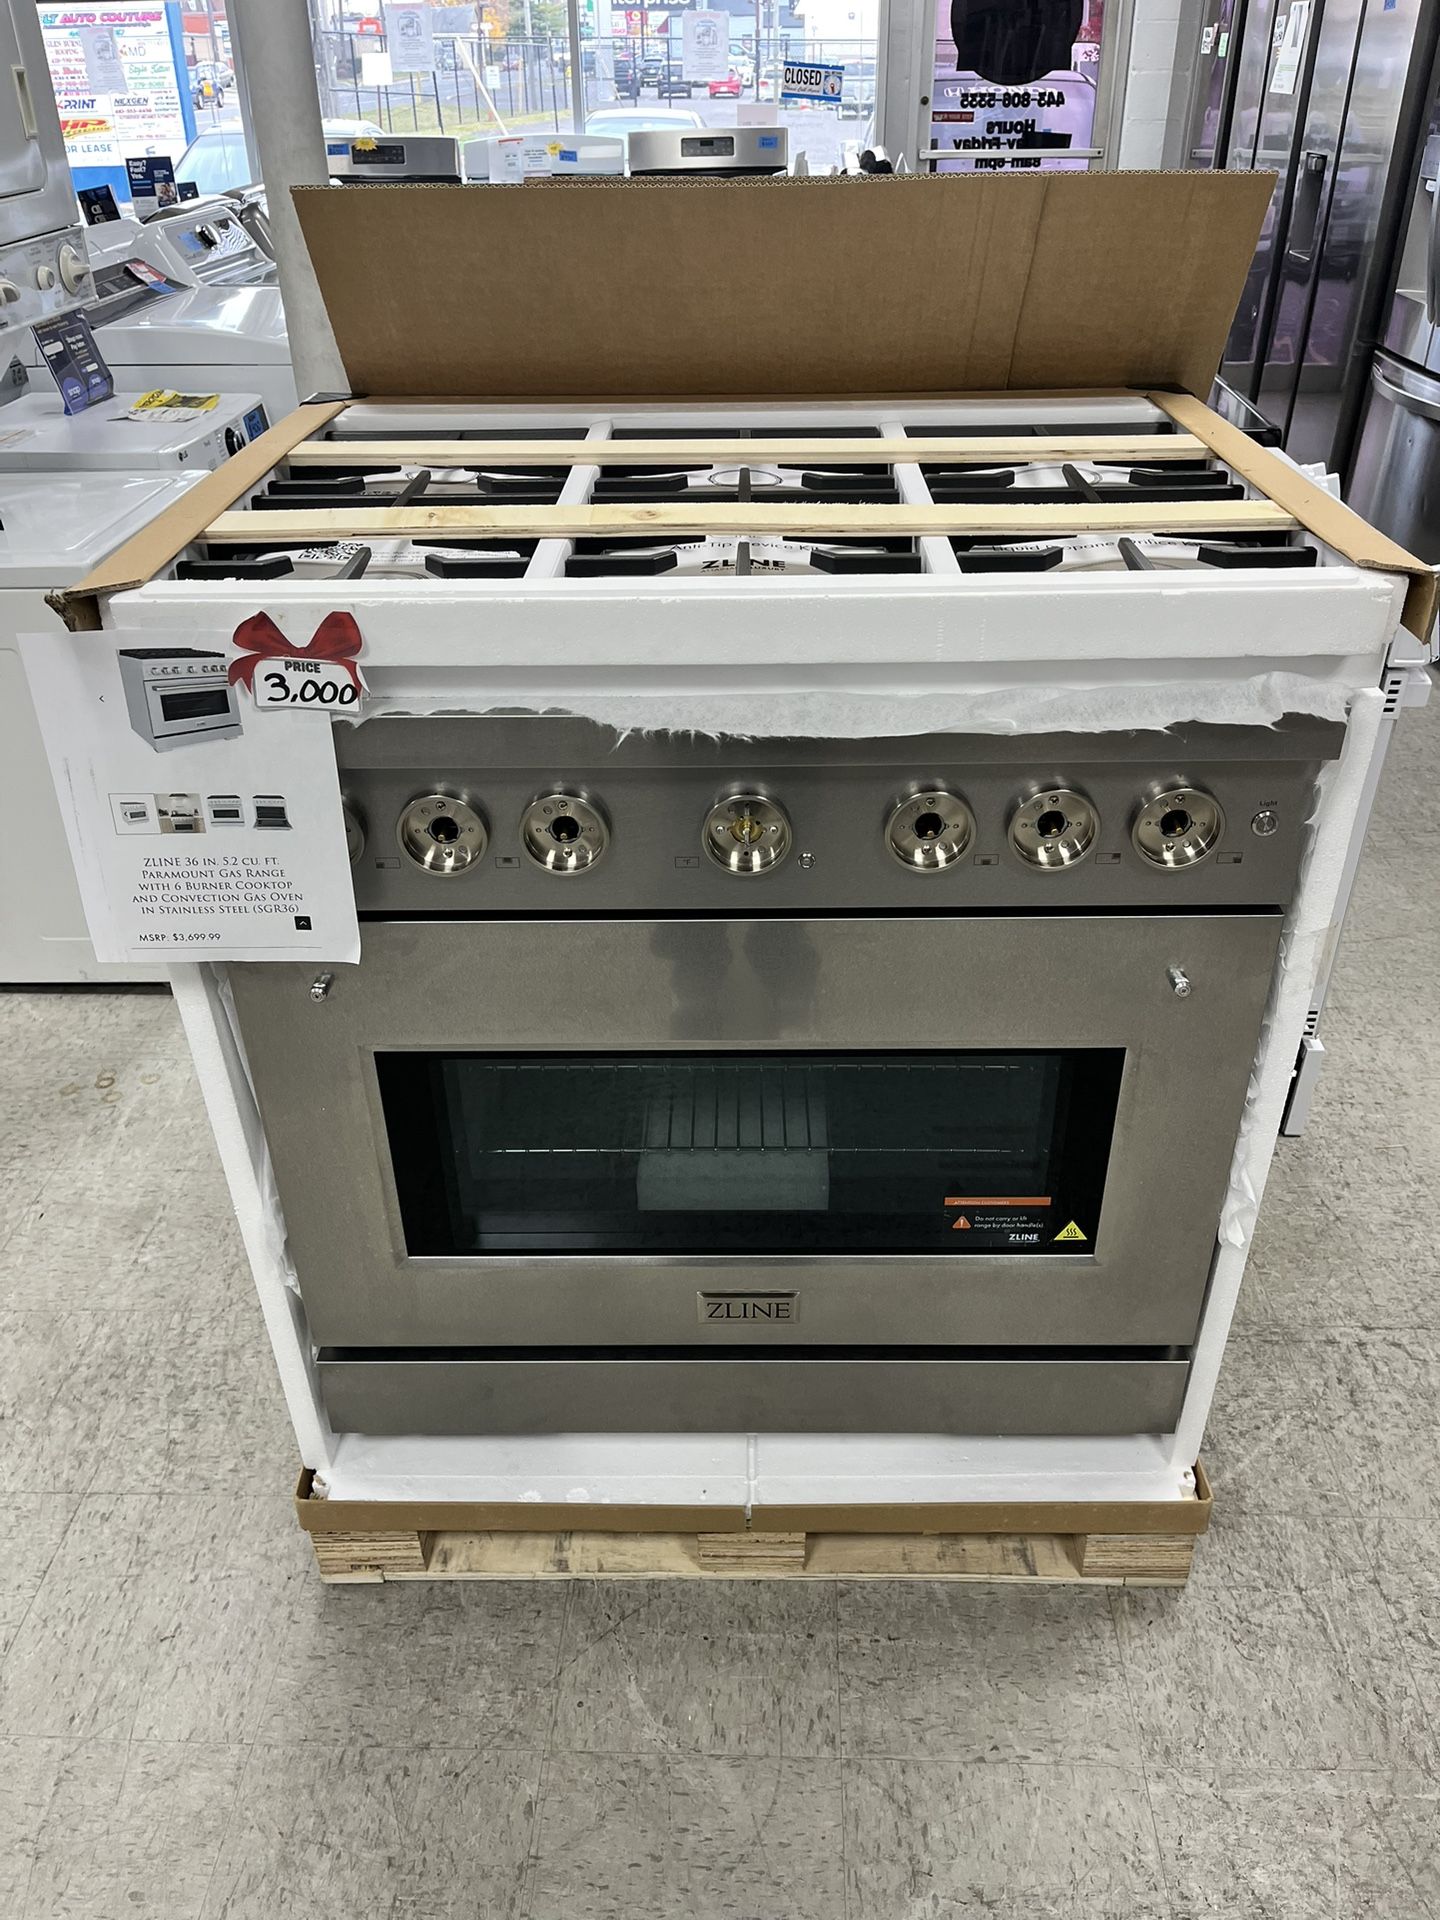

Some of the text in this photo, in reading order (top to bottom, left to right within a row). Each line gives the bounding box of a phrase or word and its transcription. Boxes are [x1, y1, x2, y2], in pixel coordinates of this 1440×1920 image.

[59, 13, 97, 23] AUTO
[100, 11, 163, 22] COUTURE
[784, 67, 822, 86] CLOSED
[114, 97, 149, 105] NEXGEN
[81, 144, 113, 153] LEASE
[751, 542, 793, 550] evice
[701, 559, 786, 569] ZLNE
[284, 661, 321, 673] PRICE
[264, 673, 358, 705] 3,000
[144, 857, 181, 867] ZLINE
[185, 857, 199, 866] 36
[223, 857, 238, 866] 5.2
[174, 882, 182, 891] 6
[253, 904, 299, 914] (SGR36)
[173, 933, 221, 942] $3,699.99
[1008, 1233, 1040, 1241] ZLINE
[706, 1302, 790, 1319] ZLINE
